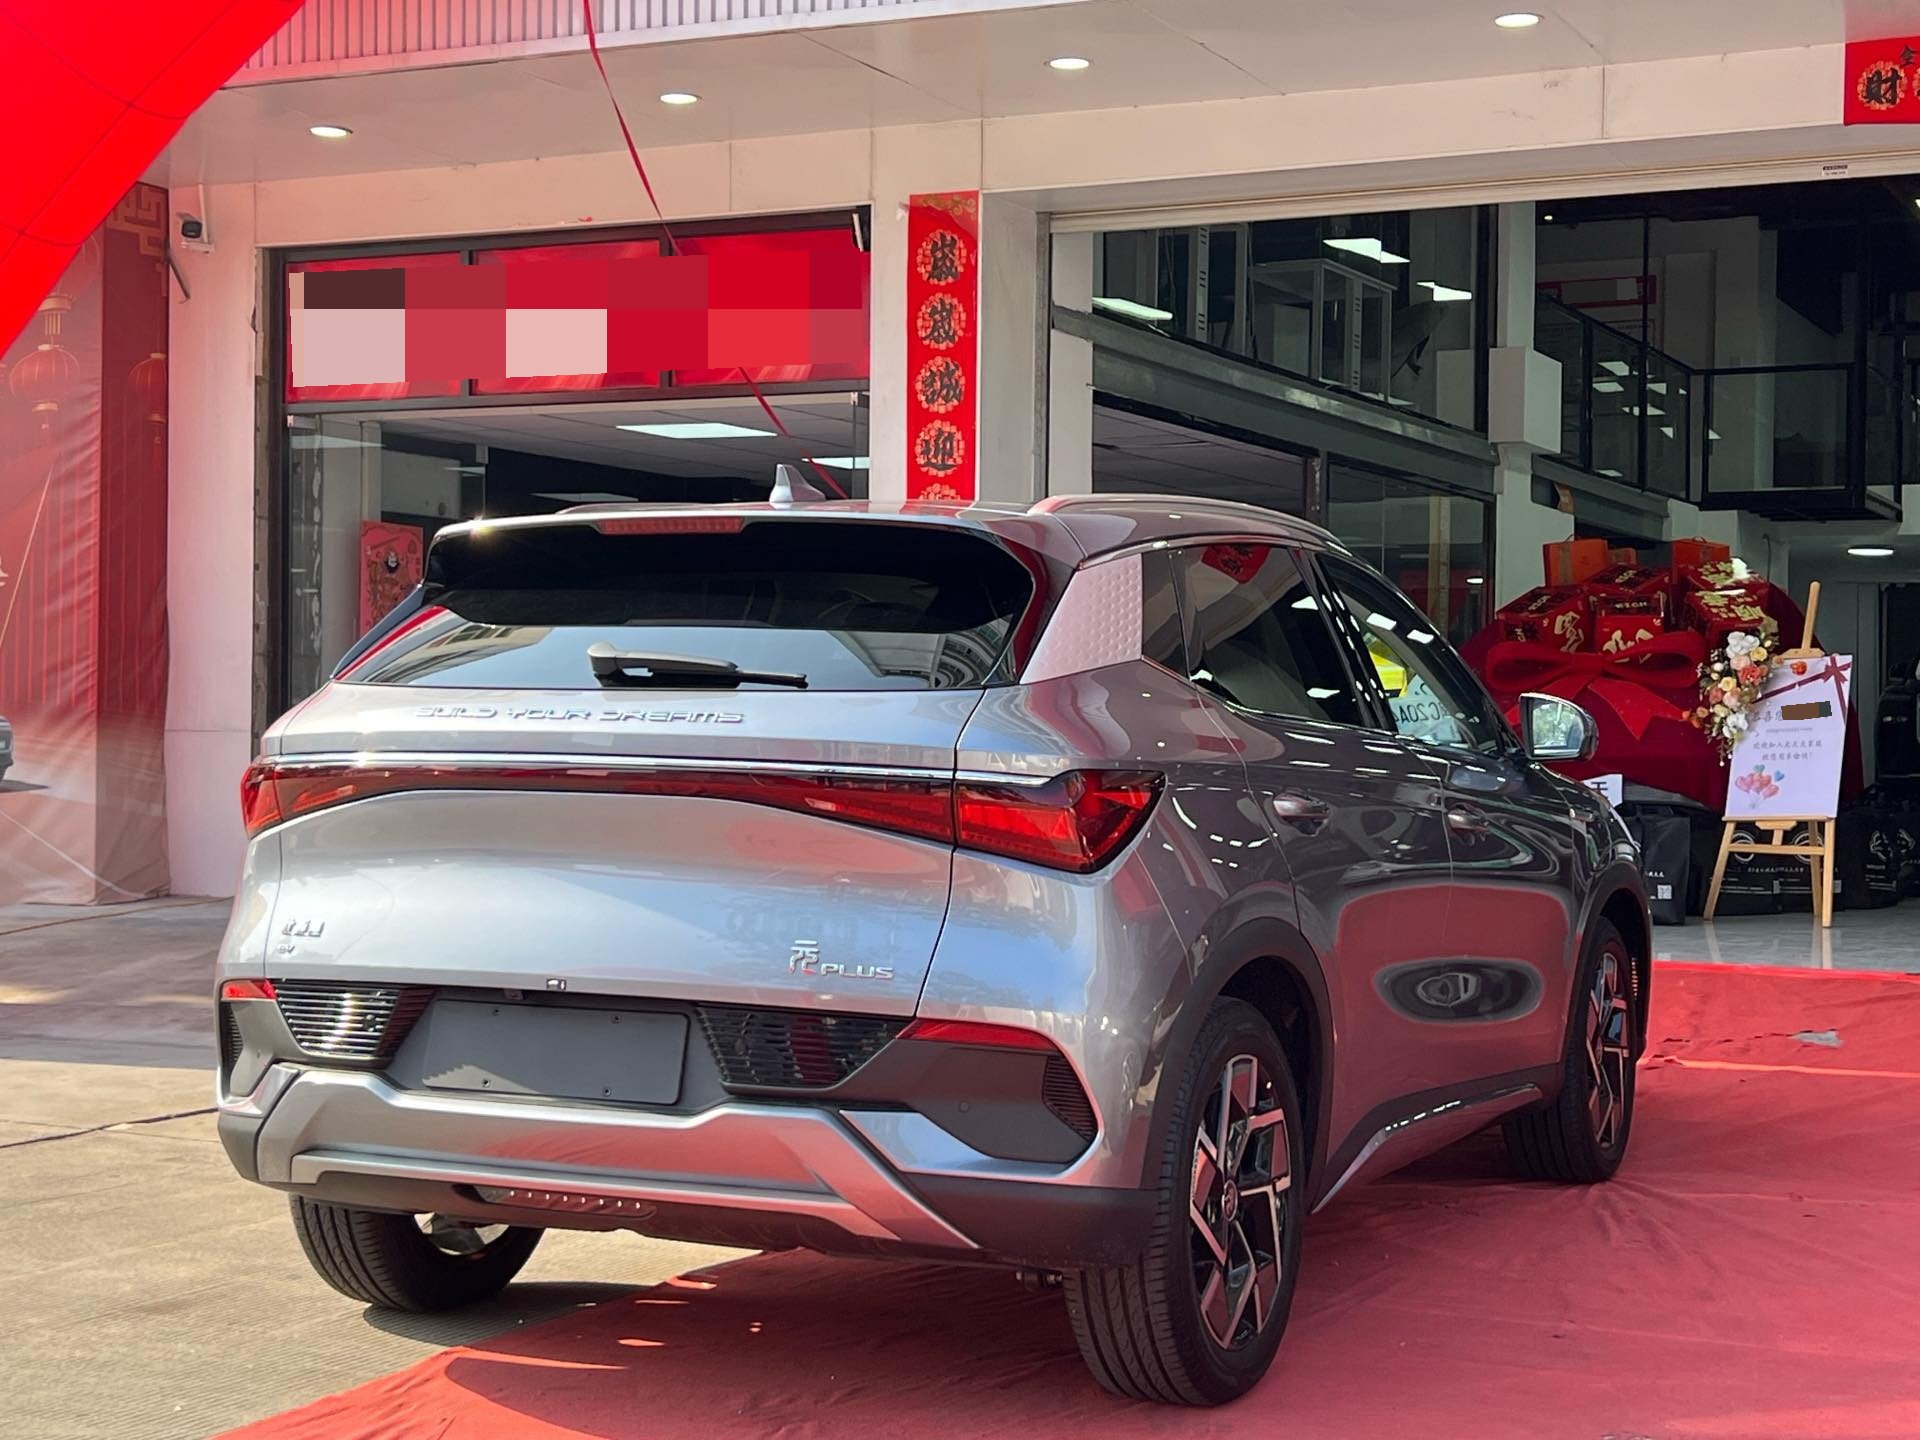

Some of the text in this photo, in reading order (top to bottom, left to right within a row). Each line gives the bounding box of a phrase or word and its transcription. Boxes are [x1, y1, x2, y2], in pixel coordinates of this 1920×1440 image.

[415, 706, 745, 725] BUILD YOUR DREAMS
